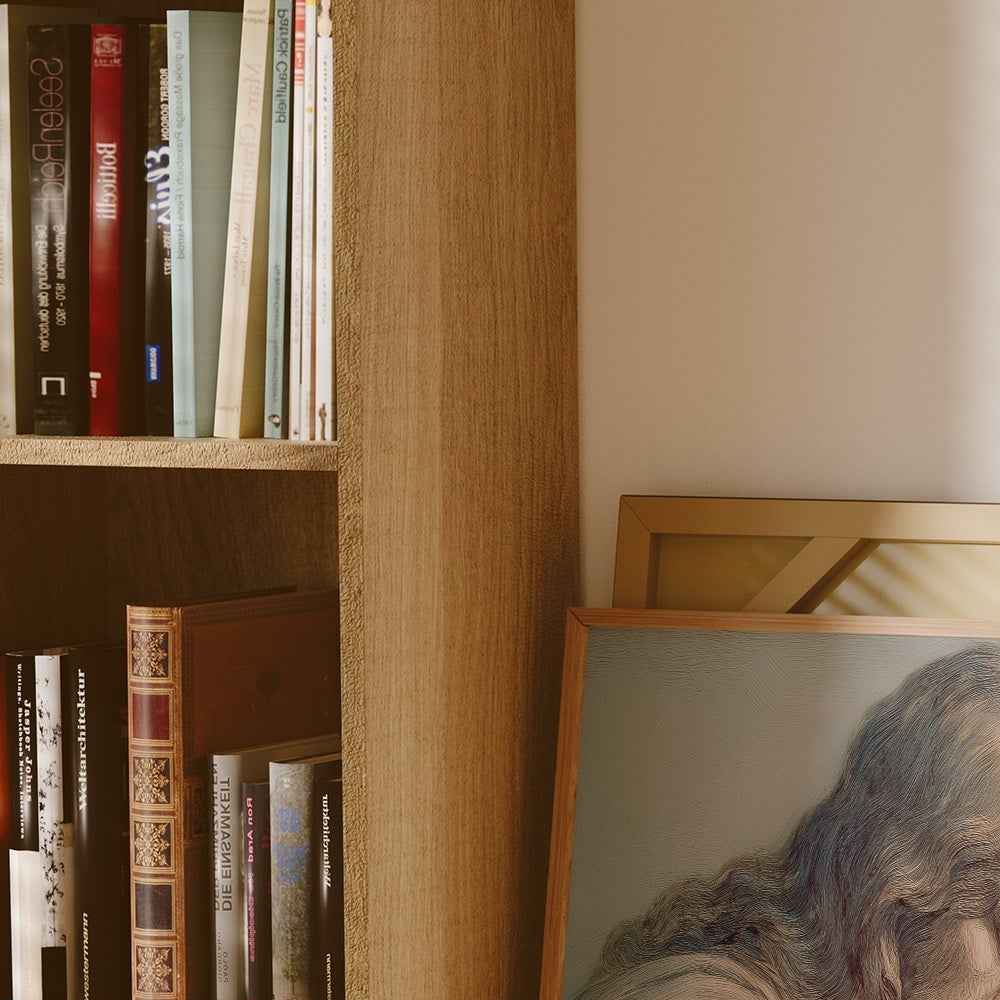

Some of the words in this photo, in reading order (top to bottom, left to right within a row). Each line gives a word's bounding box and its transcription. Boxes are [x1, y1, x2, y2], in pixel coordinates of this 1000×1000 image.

[23, 699, 32, 752] Jasper
[76, 669, 88, 811] Weltarchitektur
[25, 755, 33, 802] Johns
